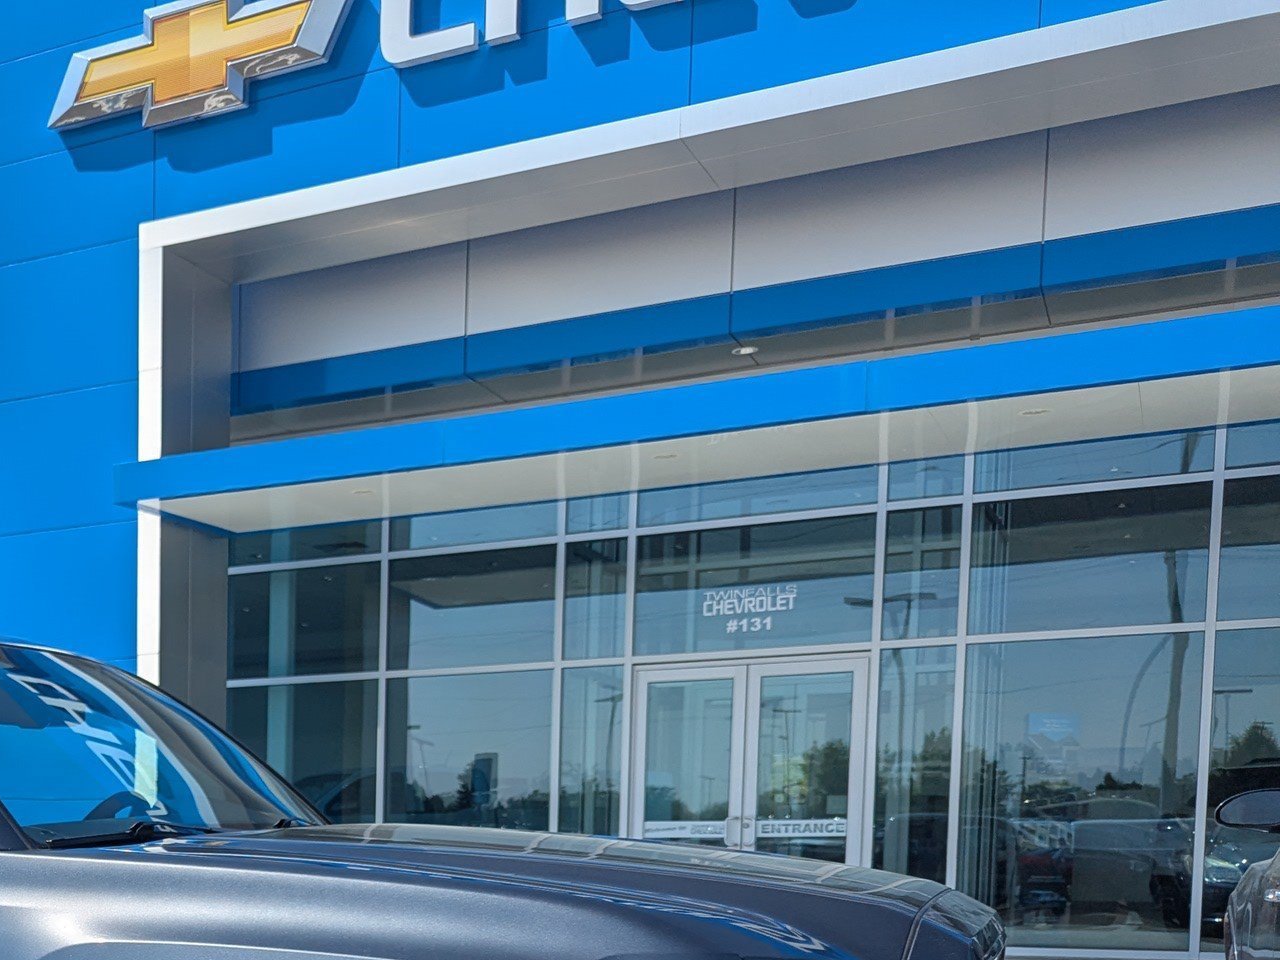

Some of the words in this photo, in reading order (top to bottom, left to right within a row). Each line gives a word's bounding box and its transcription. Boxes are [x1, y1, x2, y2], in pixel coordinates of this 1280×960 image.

[703, 594, 797, 616] CHEVROLET
[726, 616, 773, 634] #131
[761, 822, 845, 835] ENTRANCE
